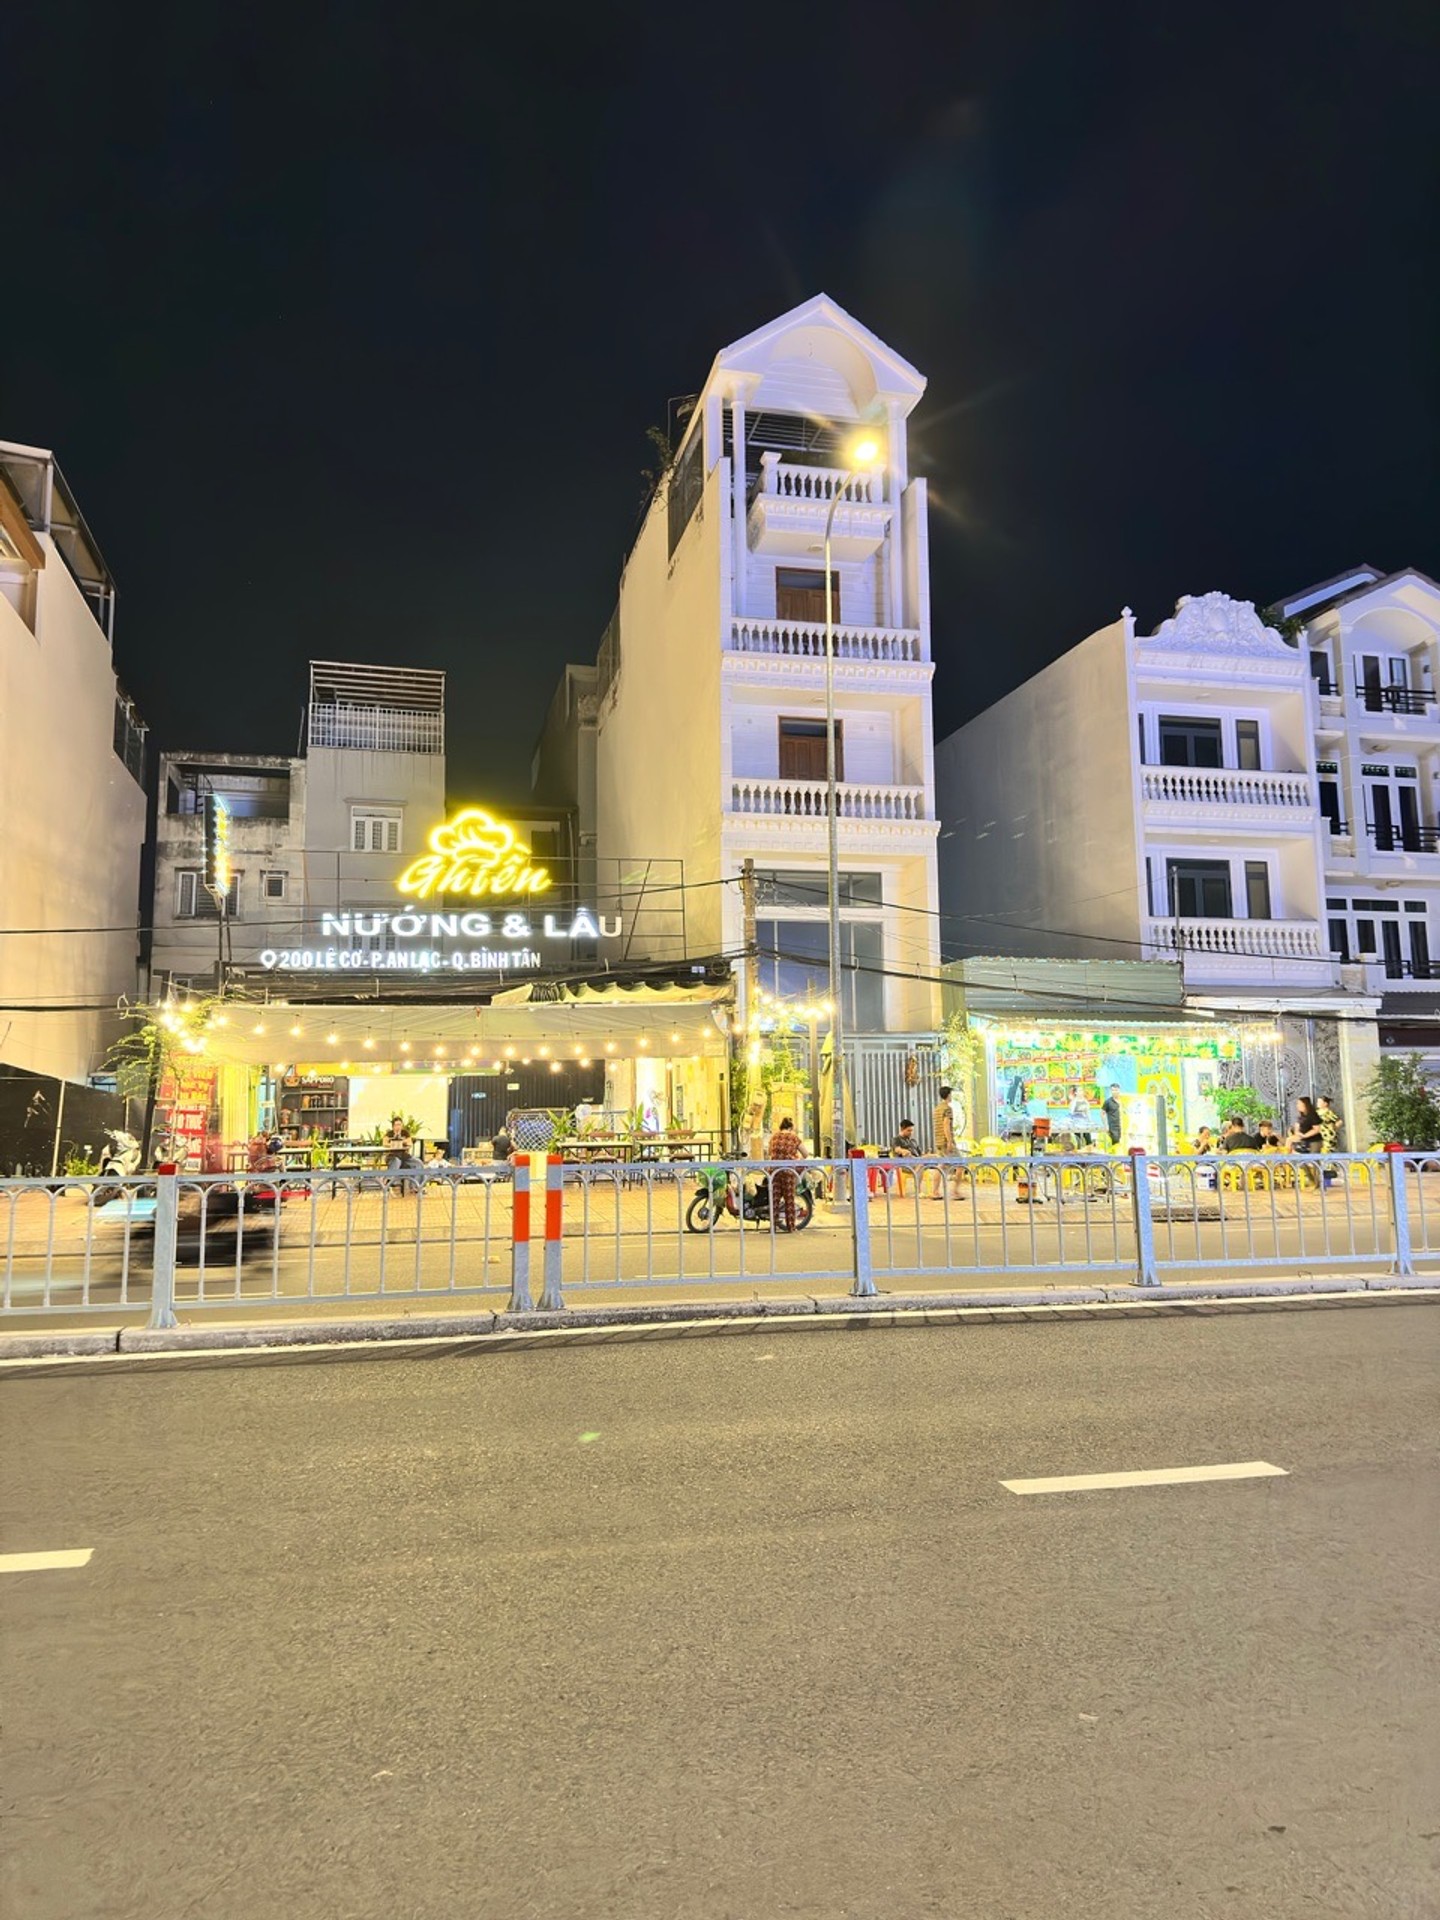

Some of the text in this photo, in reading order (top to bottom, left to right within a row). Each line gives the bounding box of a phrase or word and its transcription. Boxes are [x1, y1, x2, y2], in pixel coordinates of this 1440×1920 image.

[322, 904, 491, 937] NƯỚNG
[503, 914, 531, 937] &
[279, 951, 313, 968] 200
[315, 947, 337, 968] LÊ
[410, 951, 440, 973] LẠC
[452, 946, 508, 971] Q.BÌNH
[511, 947, 541, 968] TÂN
